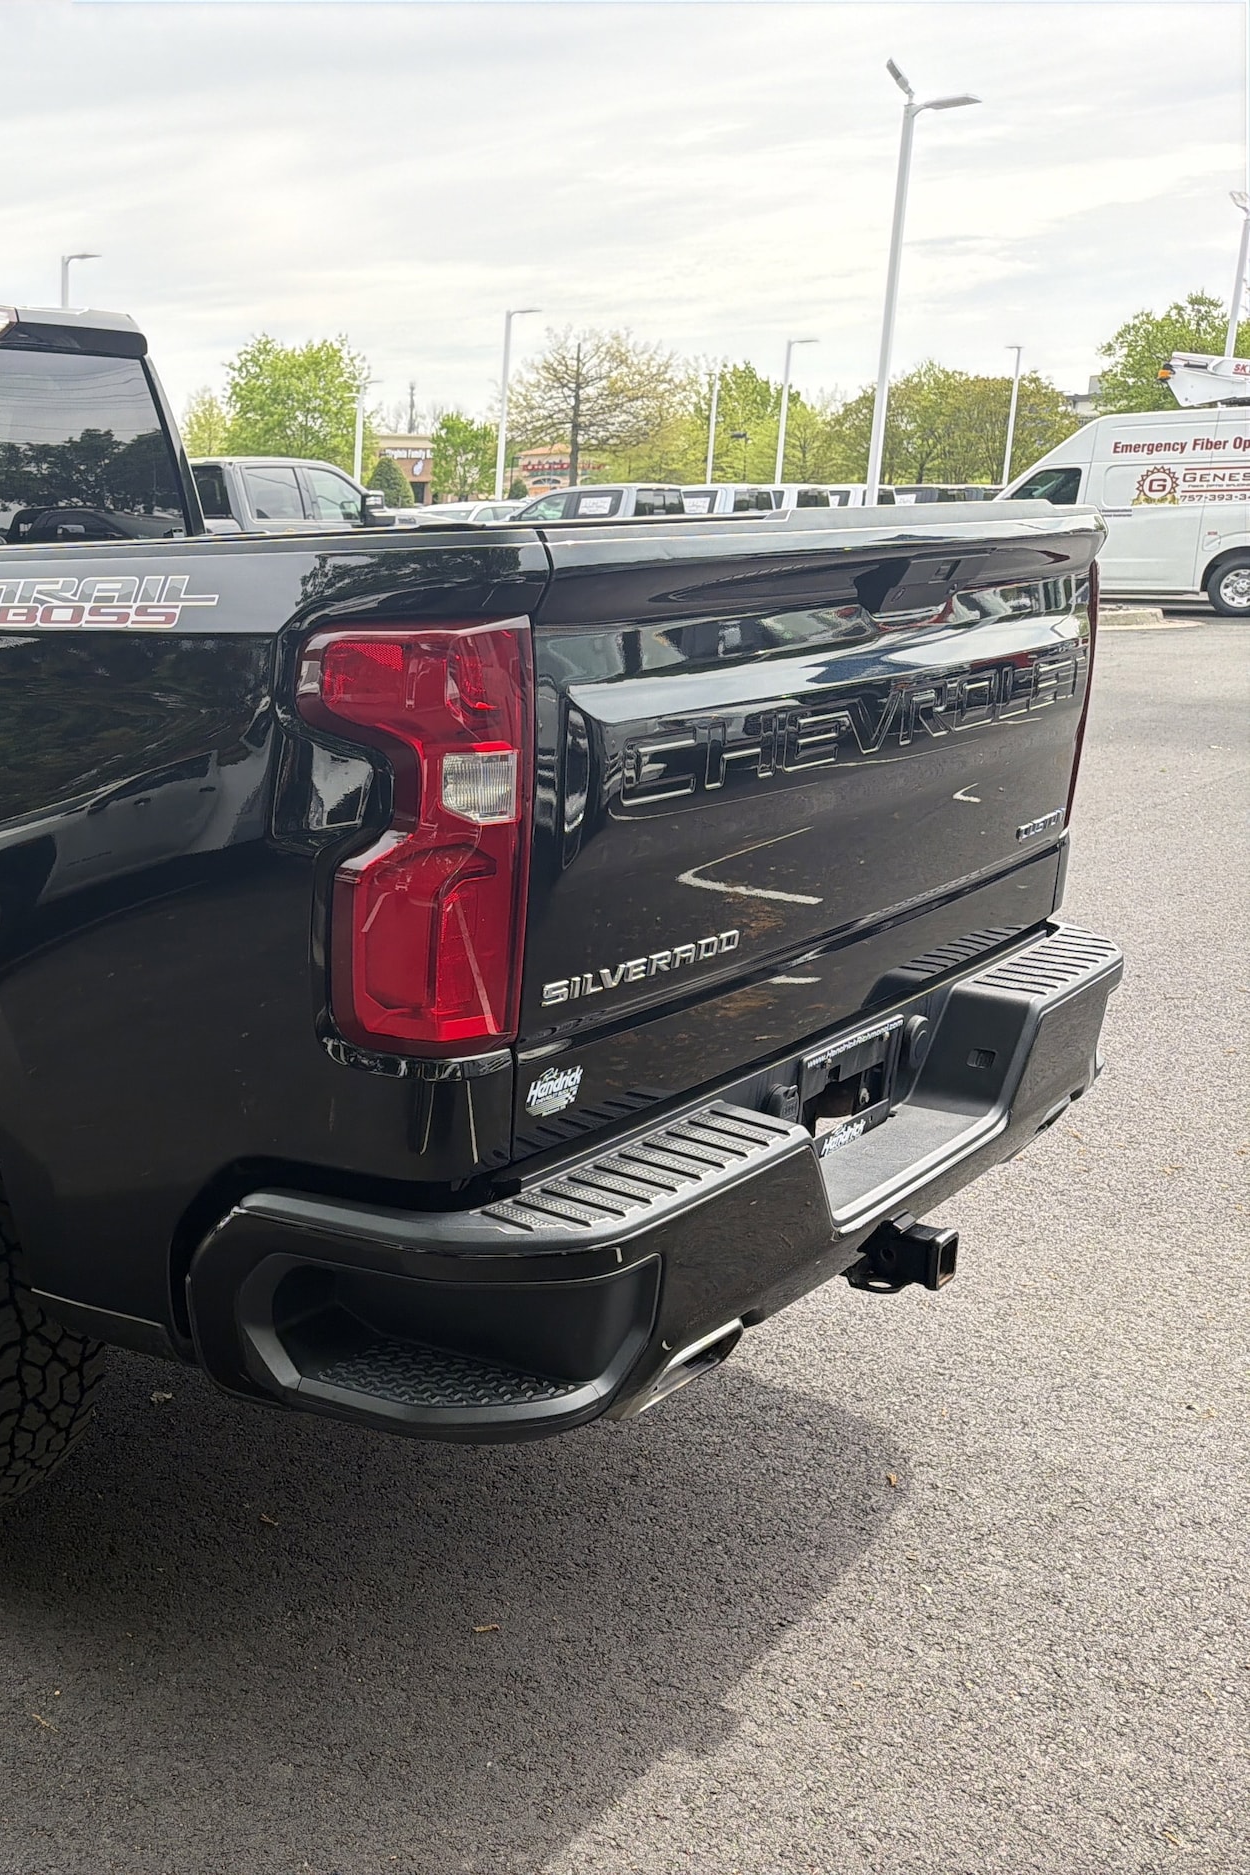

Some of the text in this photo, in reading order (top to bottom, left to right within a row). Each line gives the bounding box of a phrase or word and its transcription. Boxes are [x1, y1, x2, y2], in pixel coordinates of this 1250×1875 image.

[1113, 441, 1187, 454] Emergency
[1192, 438, 1228, 450] Fiber
[1148, 478, 1167, 492] G
[621, 649, 1086, 807] CHEVROLET
[541, 929, 740, 1007] SILVERADO
[526, 1065, 583, 1106] Hendrick
